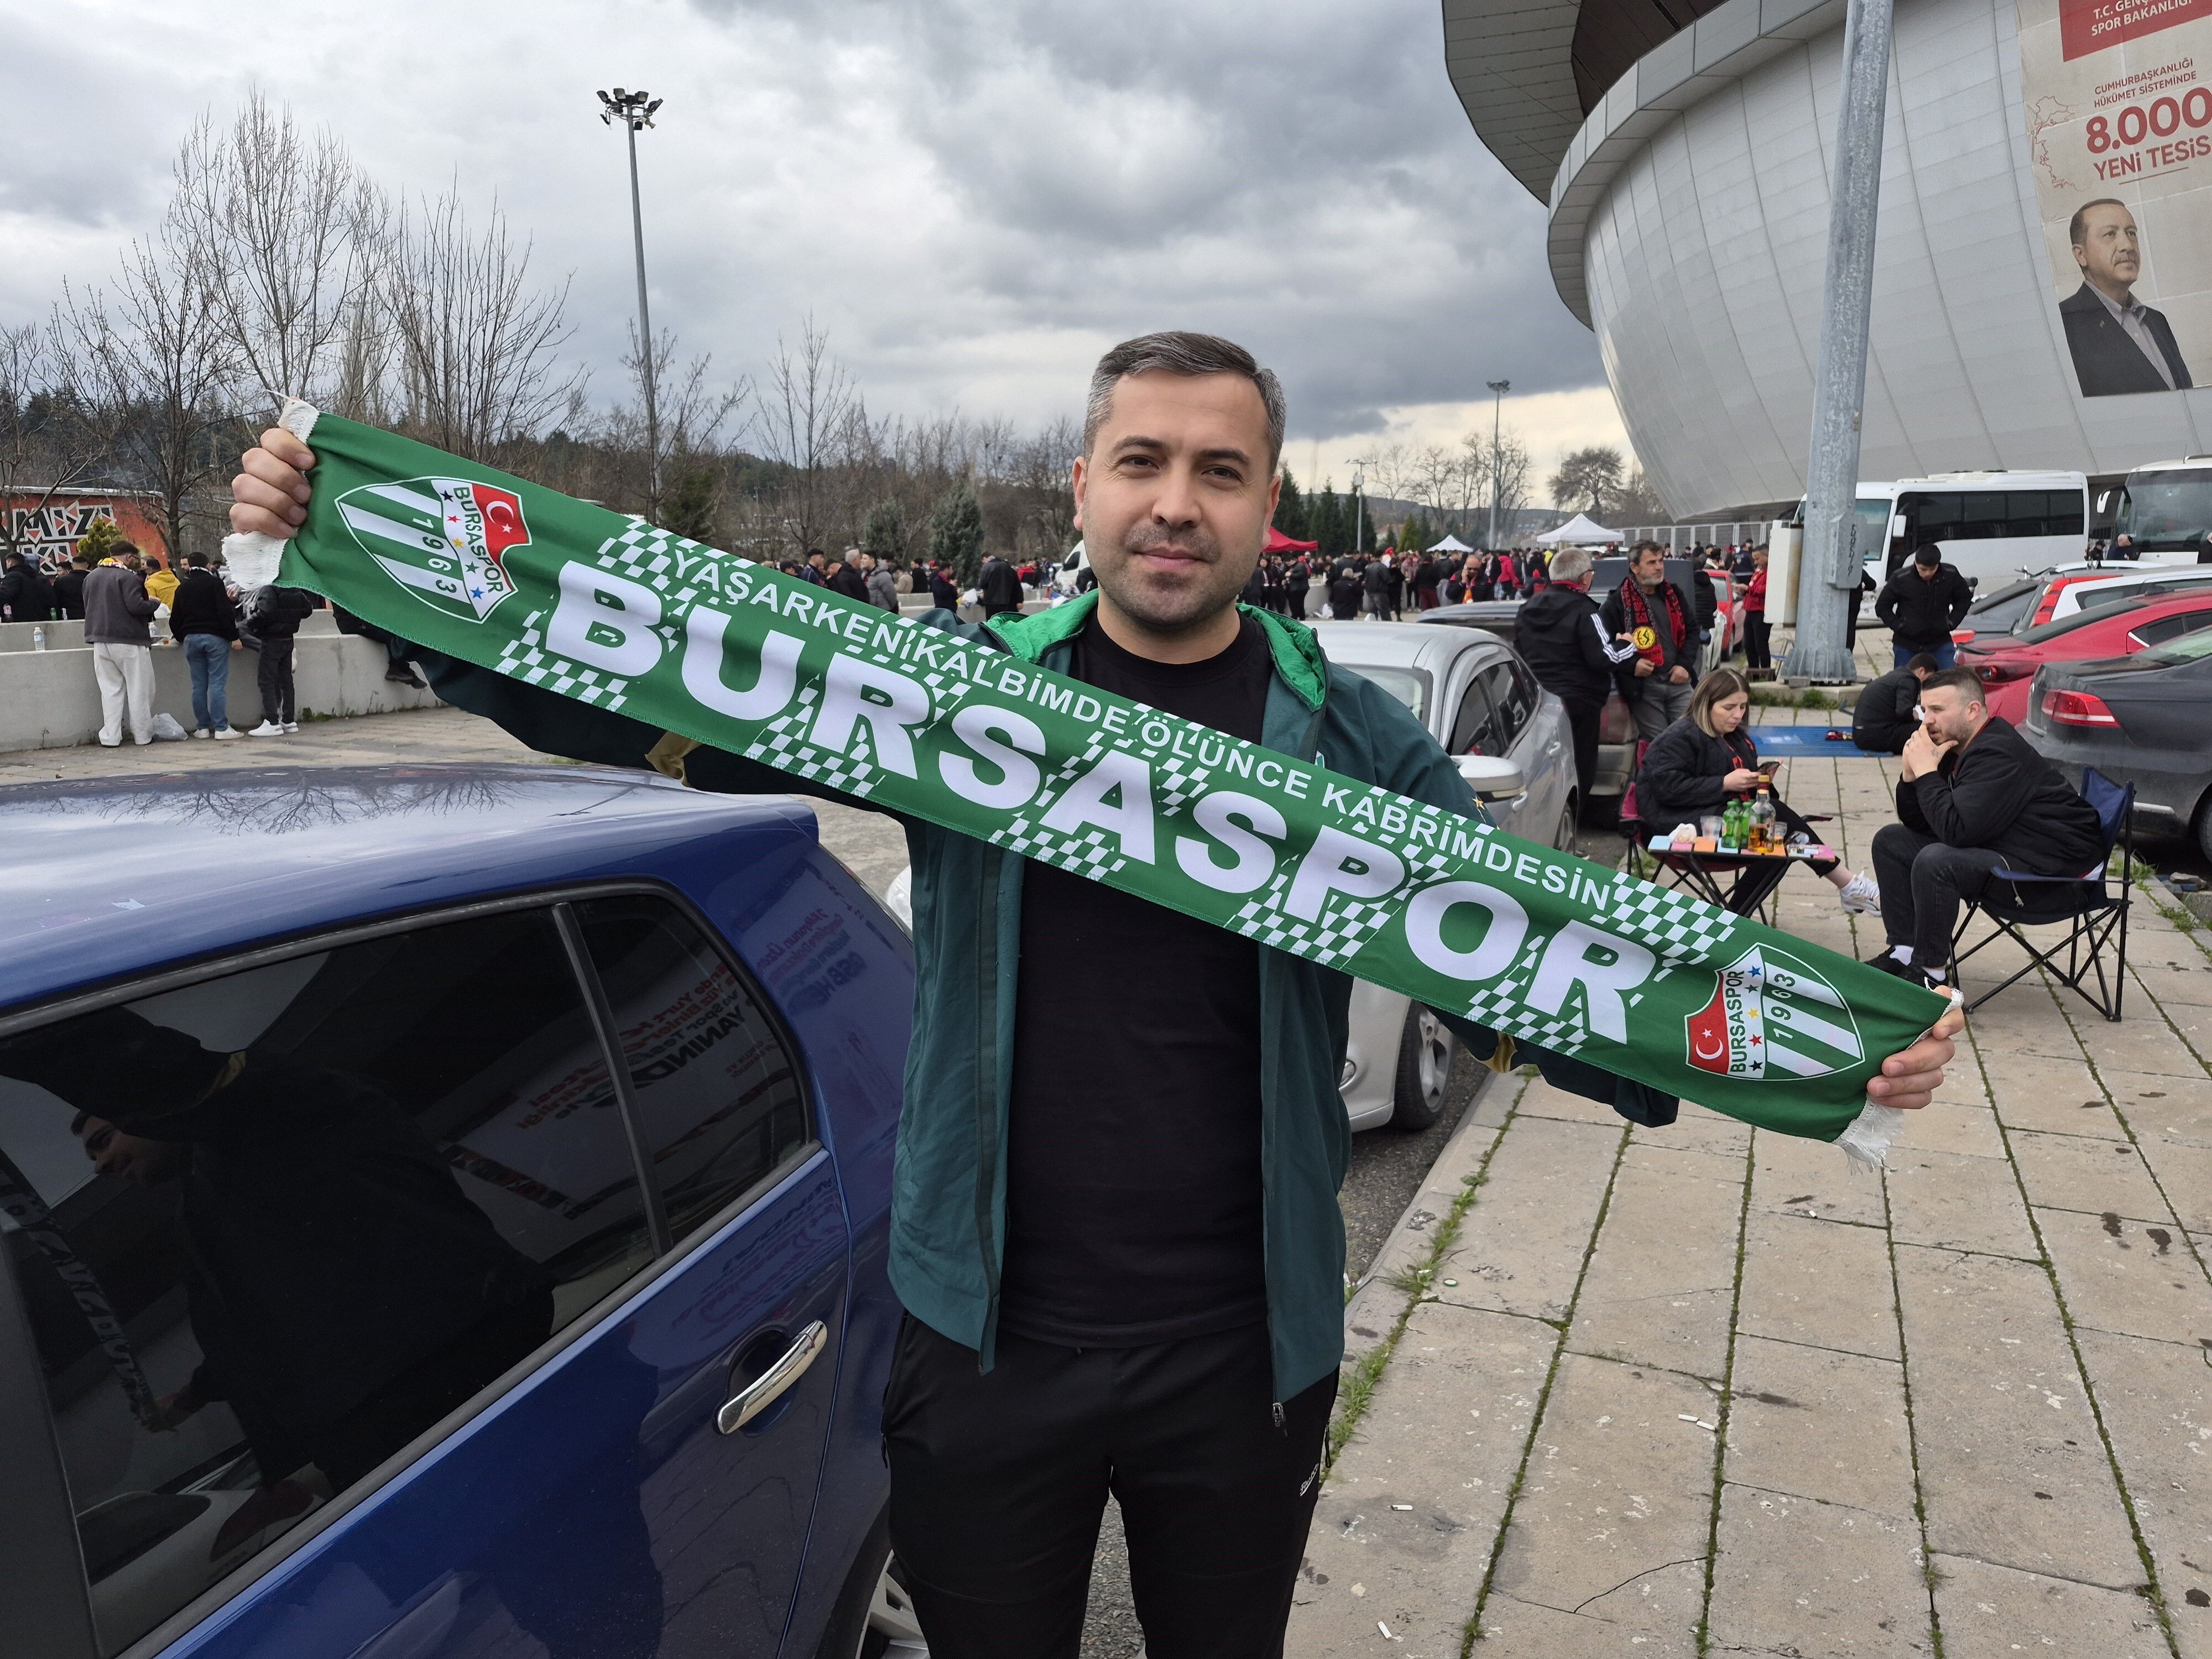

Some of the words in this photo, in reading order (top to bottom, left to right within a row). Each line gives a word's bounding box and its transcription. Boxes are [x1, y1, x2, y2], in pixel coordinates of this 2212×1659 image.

[2091, 17, 2121, 36] SPOR
[2094, 5, 2113, 19] T.C.
[2094, 88, 2136, 108] HÜKÜMET
[2140, 71, 2197, 94] SİSTEMİNDE
[2095, 58, 2193, 95] CUMHURBAŞKANLIĞI
[2086, 87, 2212, 154] 8.000
[453, 486, 504, 593] BURSASPOR
[675, 549, 903, 654] YAŞARKEN
[914, 637, 1130, 734] KALBİMDE
[1141, 716, 1312, 799] ÖLÜNCE
[1322, 782, 1610, 911] KABRİMDESİN
[545, 560, 1656, 1045] BURSASPOR
[1725, 970, 1748, 1073] BURSASPOR
